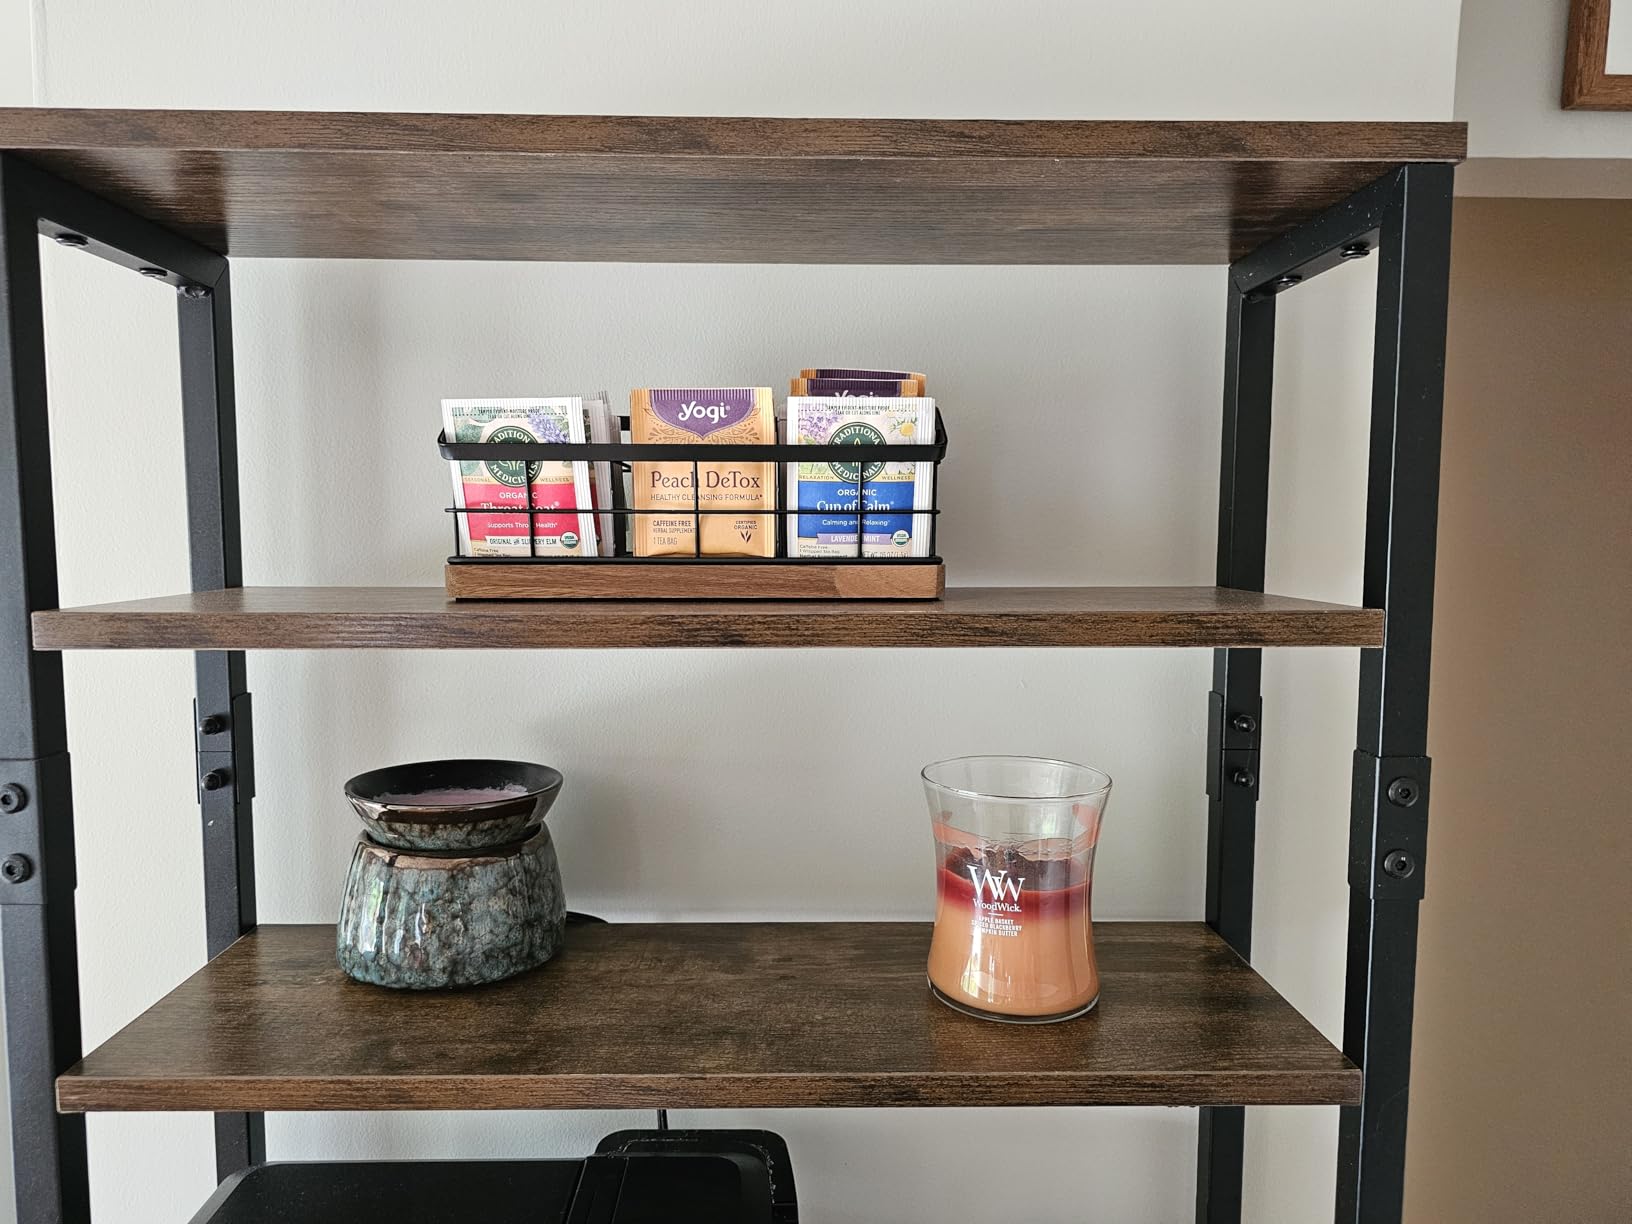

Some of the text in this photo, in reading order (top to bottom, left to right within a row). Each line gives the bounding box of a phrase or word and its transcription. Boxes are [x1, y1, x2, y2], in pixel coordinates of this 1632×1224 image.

[491, 430, 532, 443] ADITION
[833, 426, 881, 444] RADITIONA
[490, 462, 539, 484] MEDICINLS
[705, 470, 761, 488] DeTox
[832, 462, 881, 480] MEDICNALS
[650, 493, 681, 501] HEALTHY
[667, 537, 678, 545] BAG
